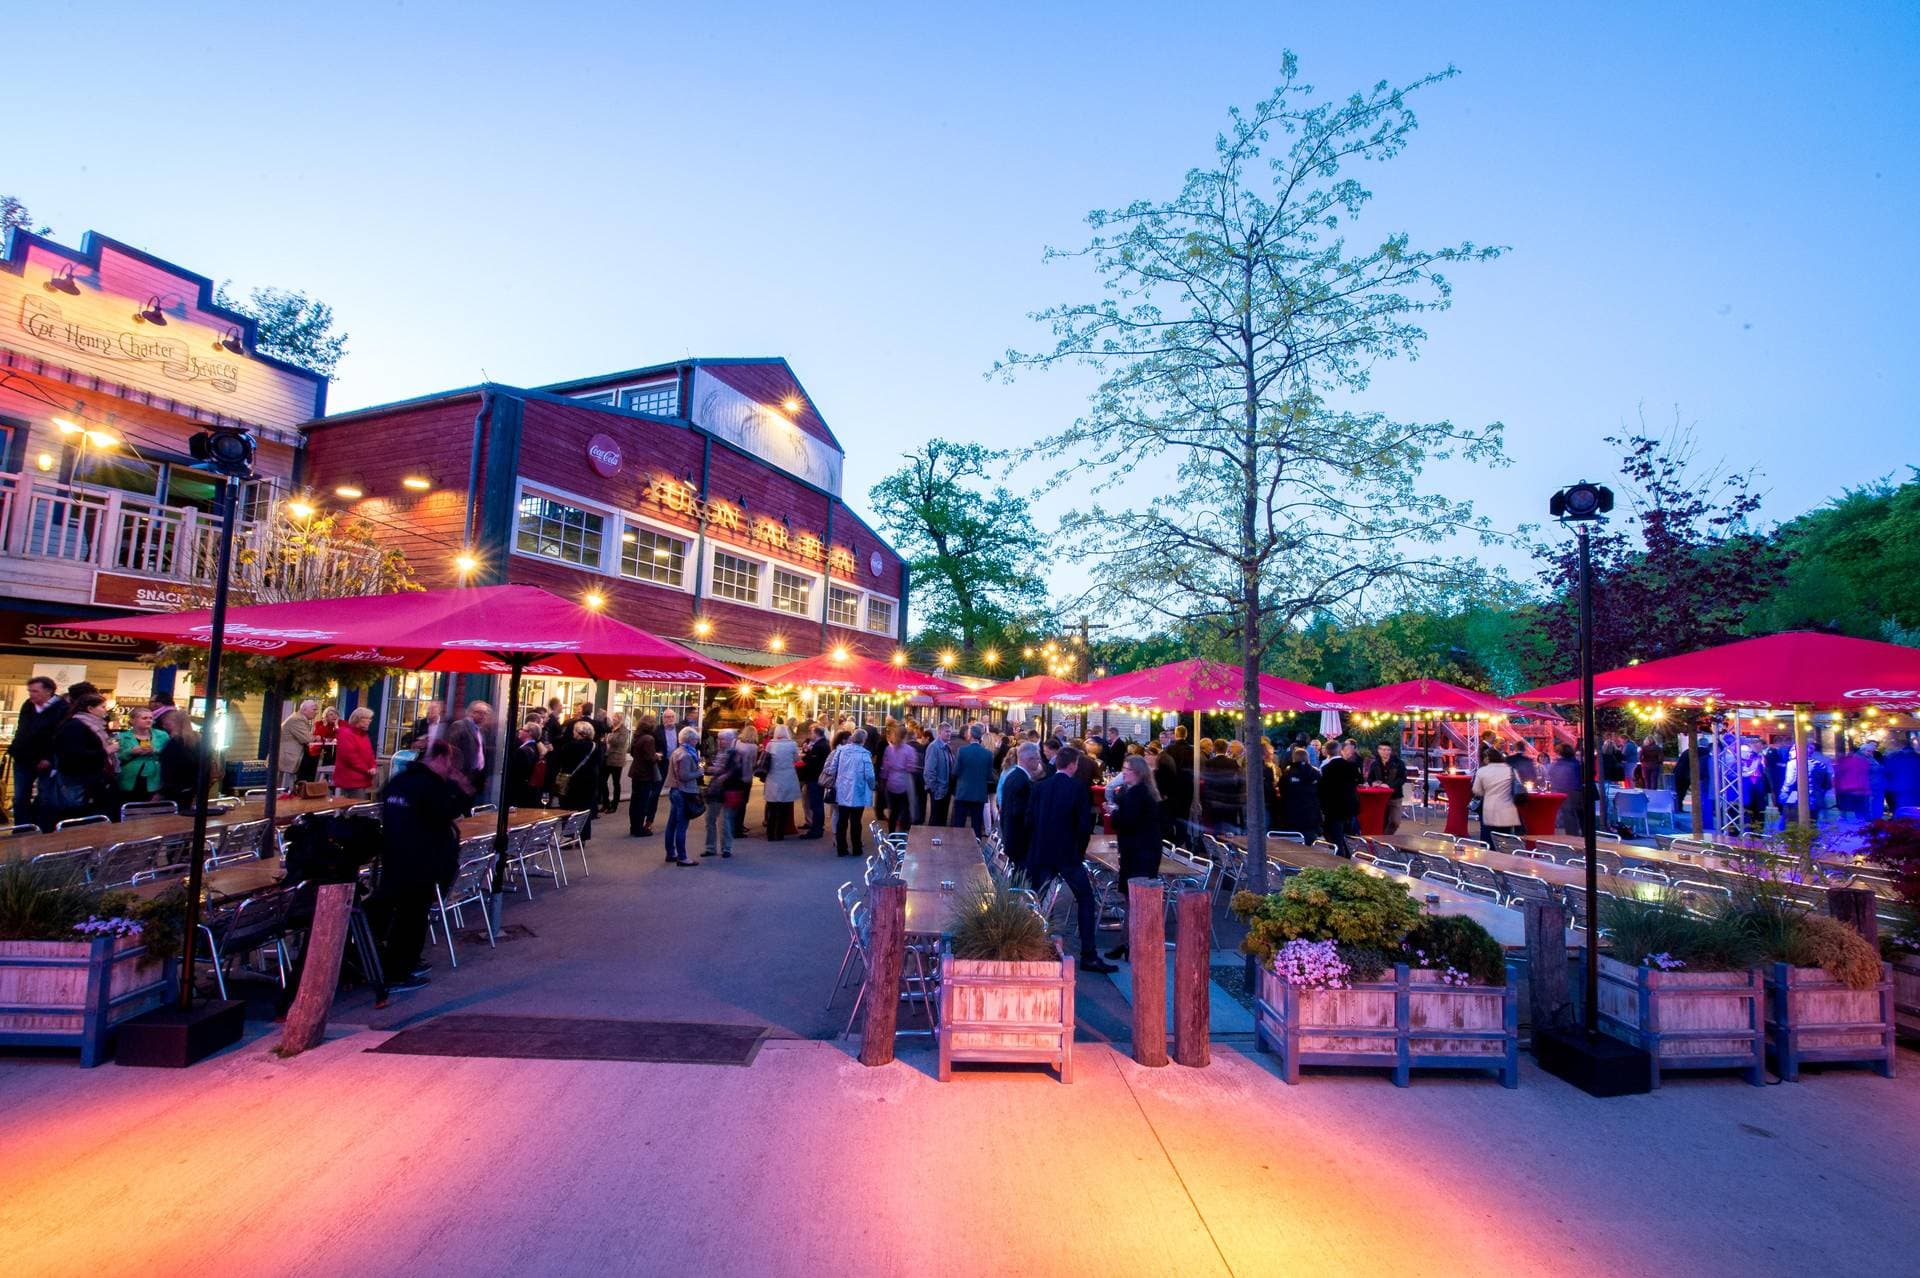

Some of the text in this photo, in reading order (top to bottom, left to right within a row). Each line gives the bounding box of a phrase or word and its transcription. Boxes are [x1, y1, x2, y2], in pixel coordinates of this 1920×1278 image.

[29, 313, 239, 381] Cpt. Henry Charter Services
[590, 445, 619, 465] Coca-Cola
[643, 472, 741, 531] YUKON
[136, 588, 185, 604] SNACK
[25, 623, 92, 640] SNACK
[1597, 686, 1721, 697] Coca-Cola
